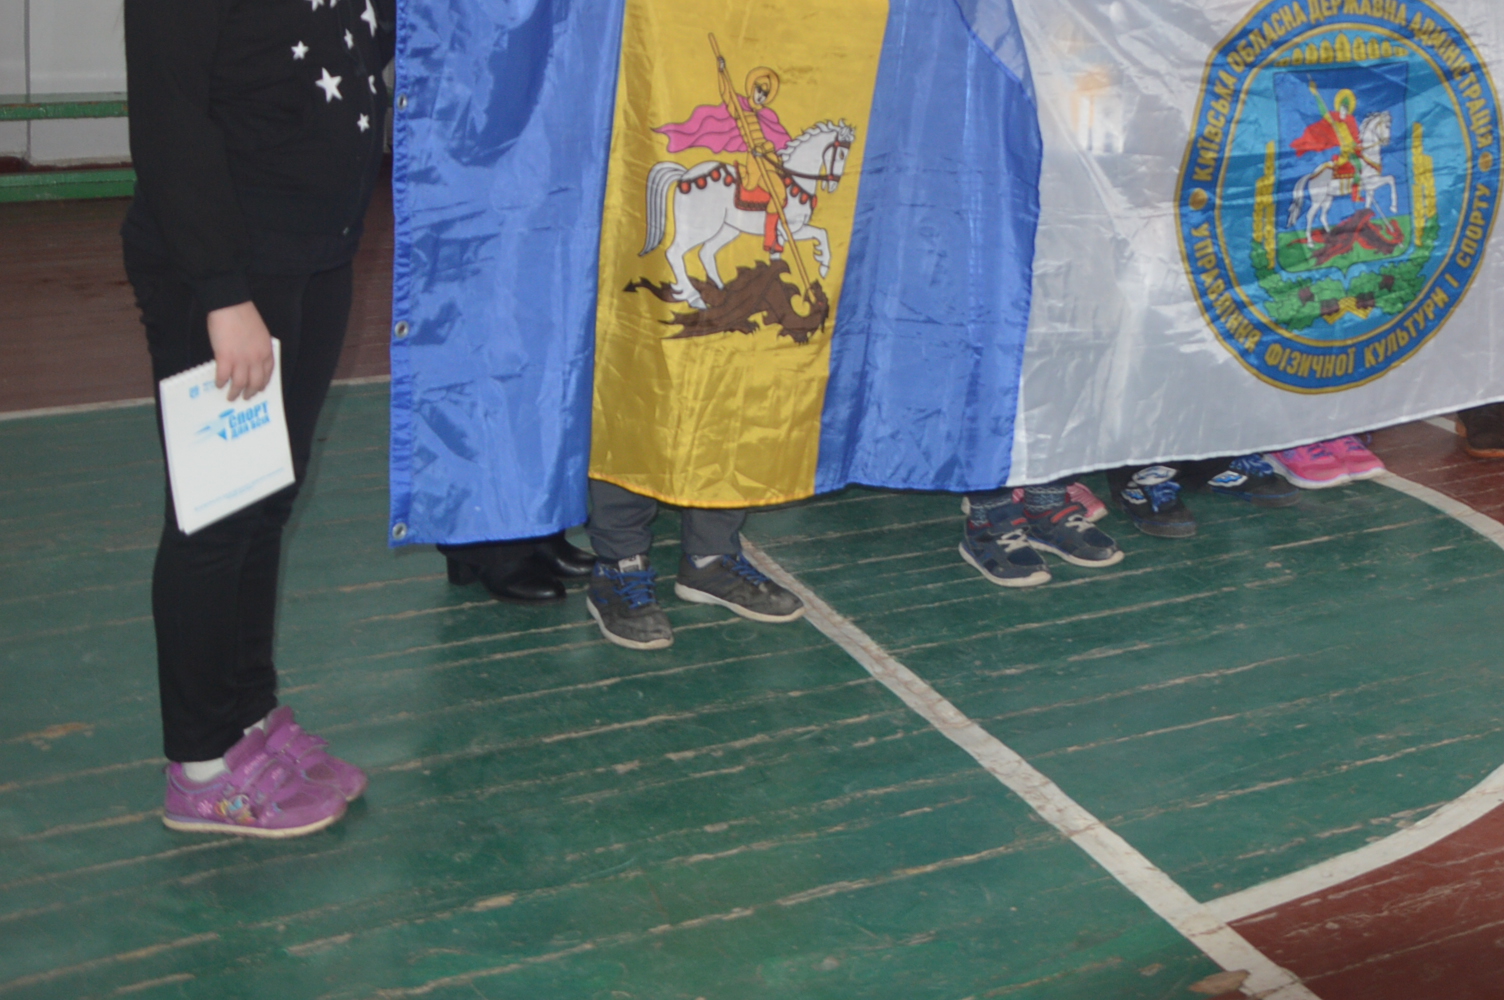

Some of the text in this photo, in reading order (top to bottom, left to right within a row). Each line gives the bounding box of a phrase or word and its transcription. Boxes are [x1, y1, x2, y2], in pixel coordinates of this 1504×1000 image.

[1192, 70, 1238, 181] КИЇВСЬКА
[1226, 1, 1308, 73] ОБЛАСНА
[1408, 11, 1493, 149] АДМІНІСТРАЦІЯ
[1191, 222, 1262, 352] УПРАВЛІННЯ
[1264, 343, 1356, 378] ФІЗИЧНОЇ
[1364, 286, 1449, 368] КУЛЬТУРИ
[1455, 183, 1491, 268] СПОРТУ
